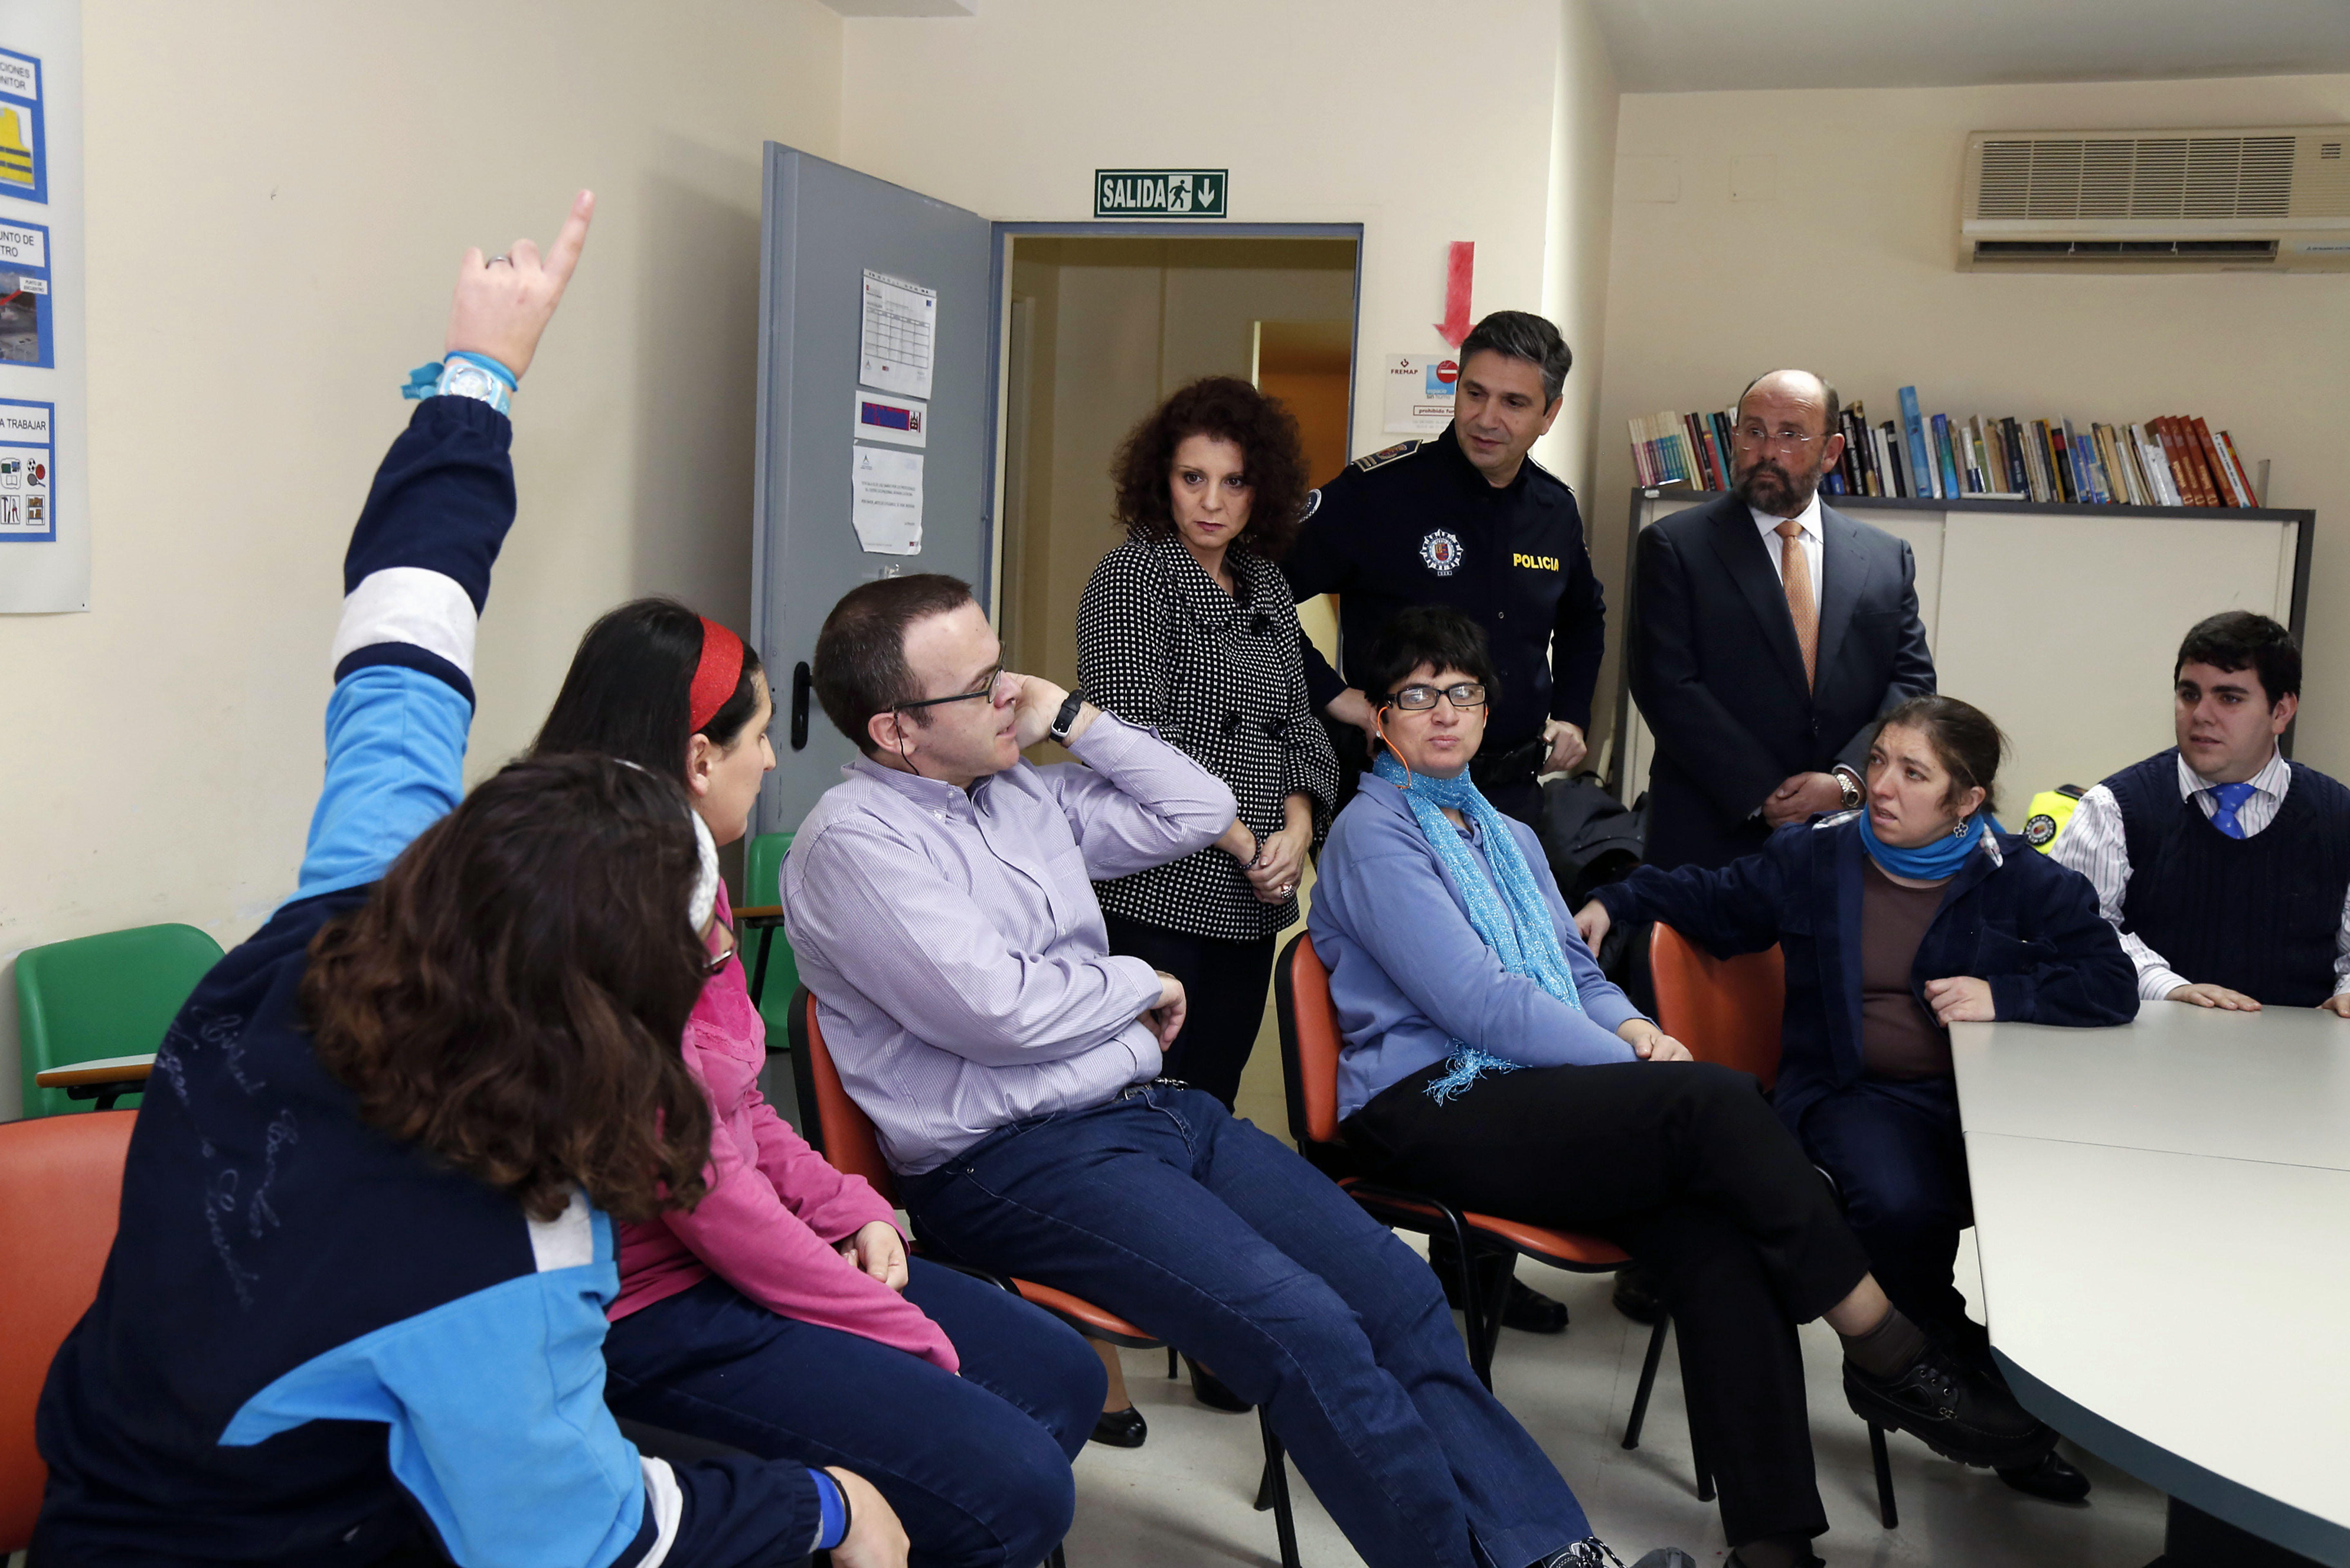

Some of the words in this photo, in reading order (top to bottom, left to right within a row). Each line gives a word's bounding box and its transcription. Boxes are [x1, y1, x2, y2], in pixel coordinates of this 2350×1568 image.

[1103, 178, 1166, 208] SALIDA
[23, 234, 34, 245] DE
[0, 418, 5, 428] A
[7, 418, 46, 430] TRABAJAR
[1513, 553, 1559, 572] POLICIA
